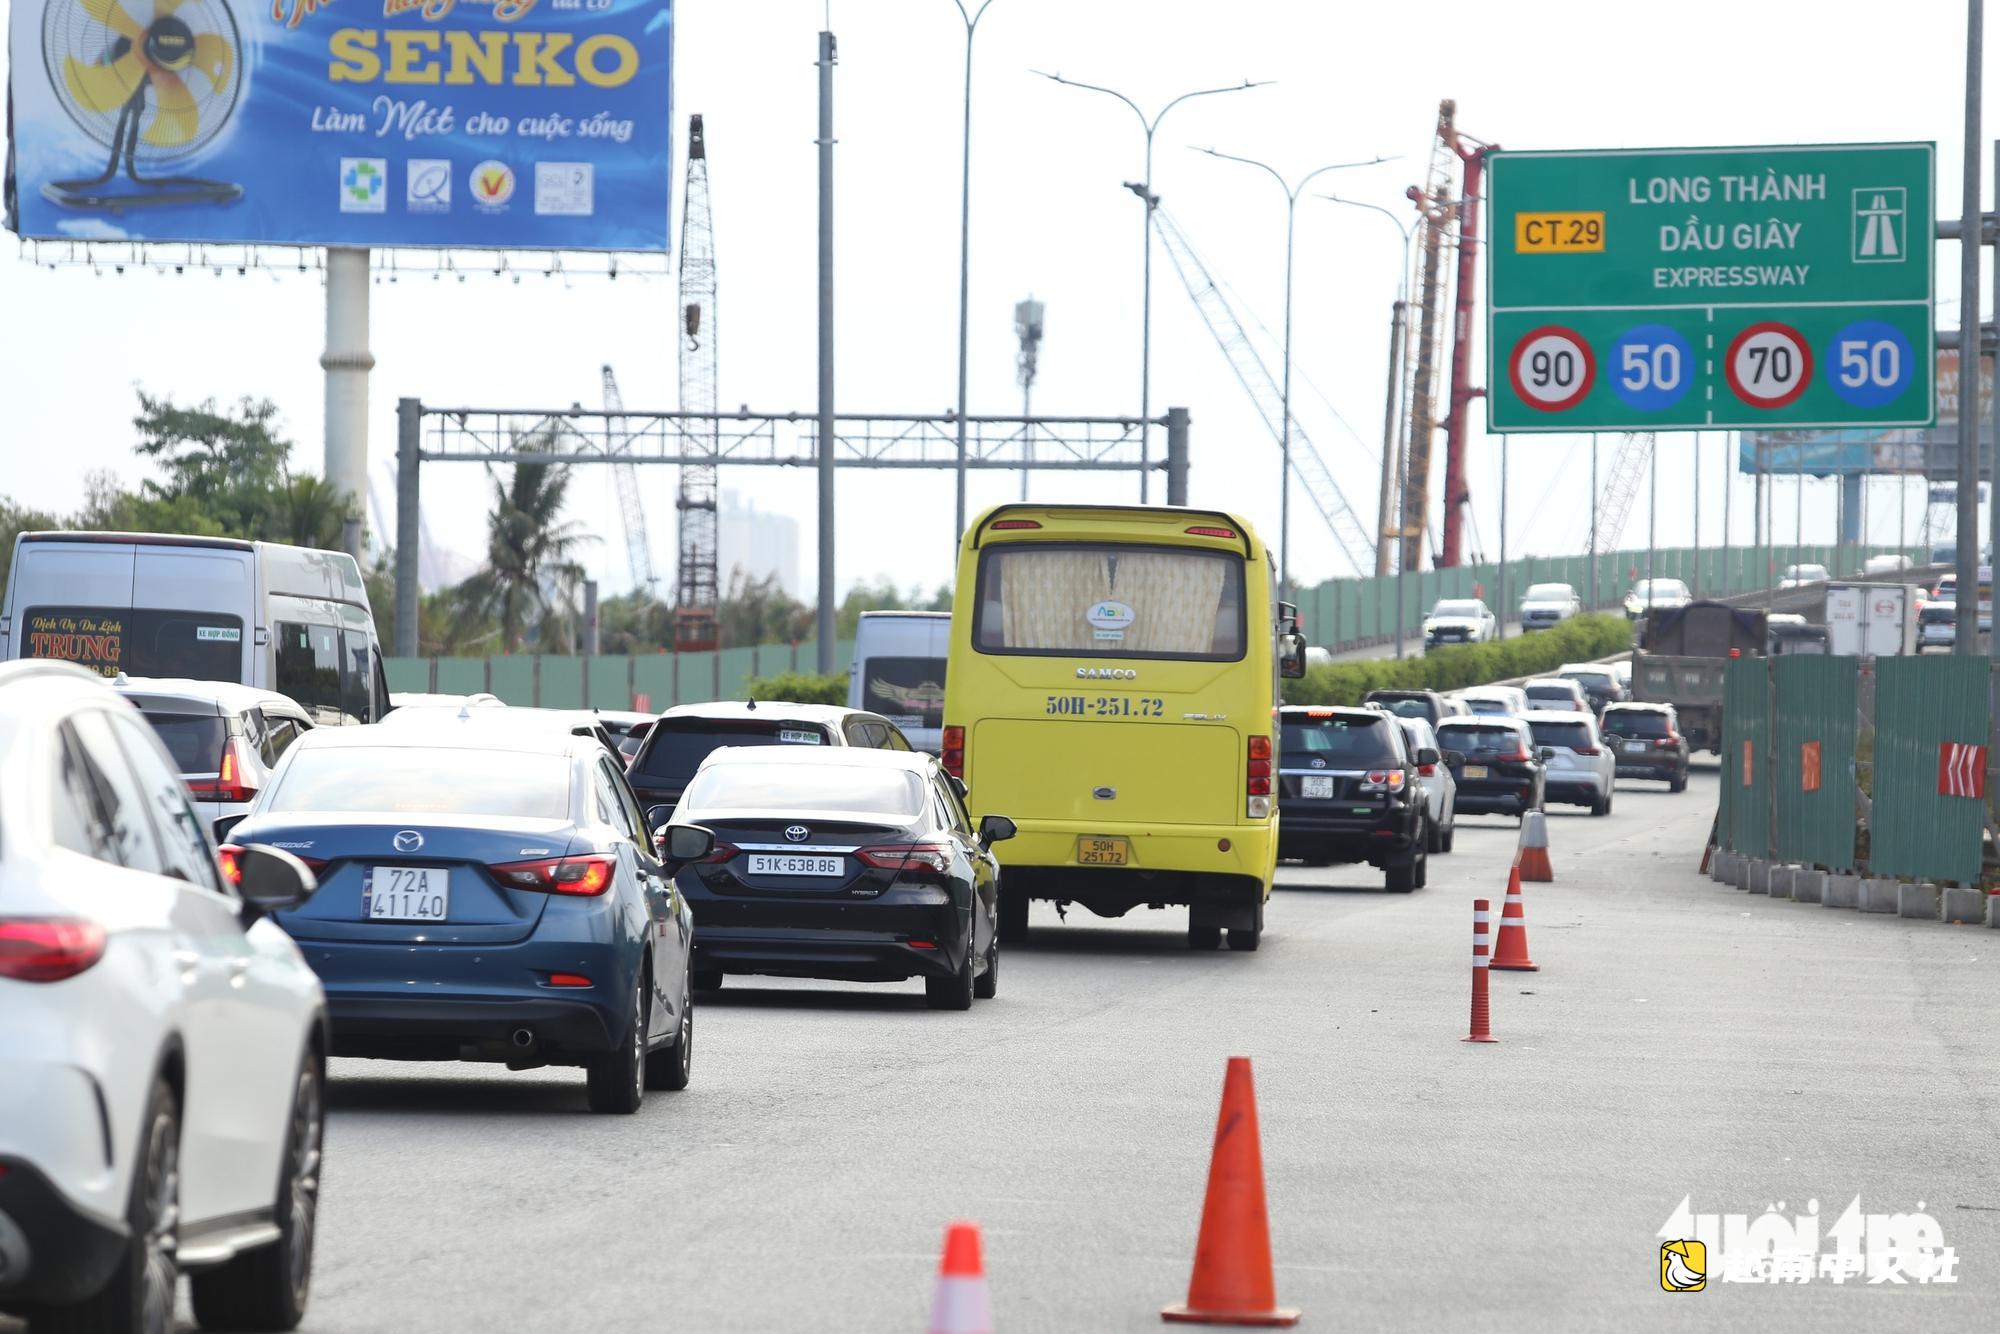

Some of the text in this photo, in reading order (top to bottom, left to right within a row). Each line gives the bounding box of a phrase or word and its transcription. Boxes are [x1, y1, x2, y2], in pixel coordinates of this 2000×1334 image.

[328, 27, 640, 89] SENKO
[311, 95, 634, 143] Làm Mát cho cuộc sống
[1628, 167, 1827, 204] LONG THÀNH
[1524, 219, 1601, 246] CT.29
[1659, 213, 1803, 252] DẦU GIÂY
[1653, 265, 1810, 289] EXPRESSWAY
[1531, 349, 1575, 387] 90
[1621, 343, 1682, 392] 50
[1748, 345, 1792, 385] 70
[1839, 339, 1900, 388] 50
[31, 616, 122, 633] Dịch Vụ Du Lịch
[31, 632, 121, 661] TRUNG
[1076, 667, 1137, 680] SAMCO
[1046, 696, 1164, 717] 50H-251.72
[1084, 851, 1122, 863] 251.72
[1092, 840, 1114, 852] 50H
[756, 857, 836, 873] 51K-638.86
[390, 869, 429, 893] 72A
[372, 894, 444, 918] 411.40
